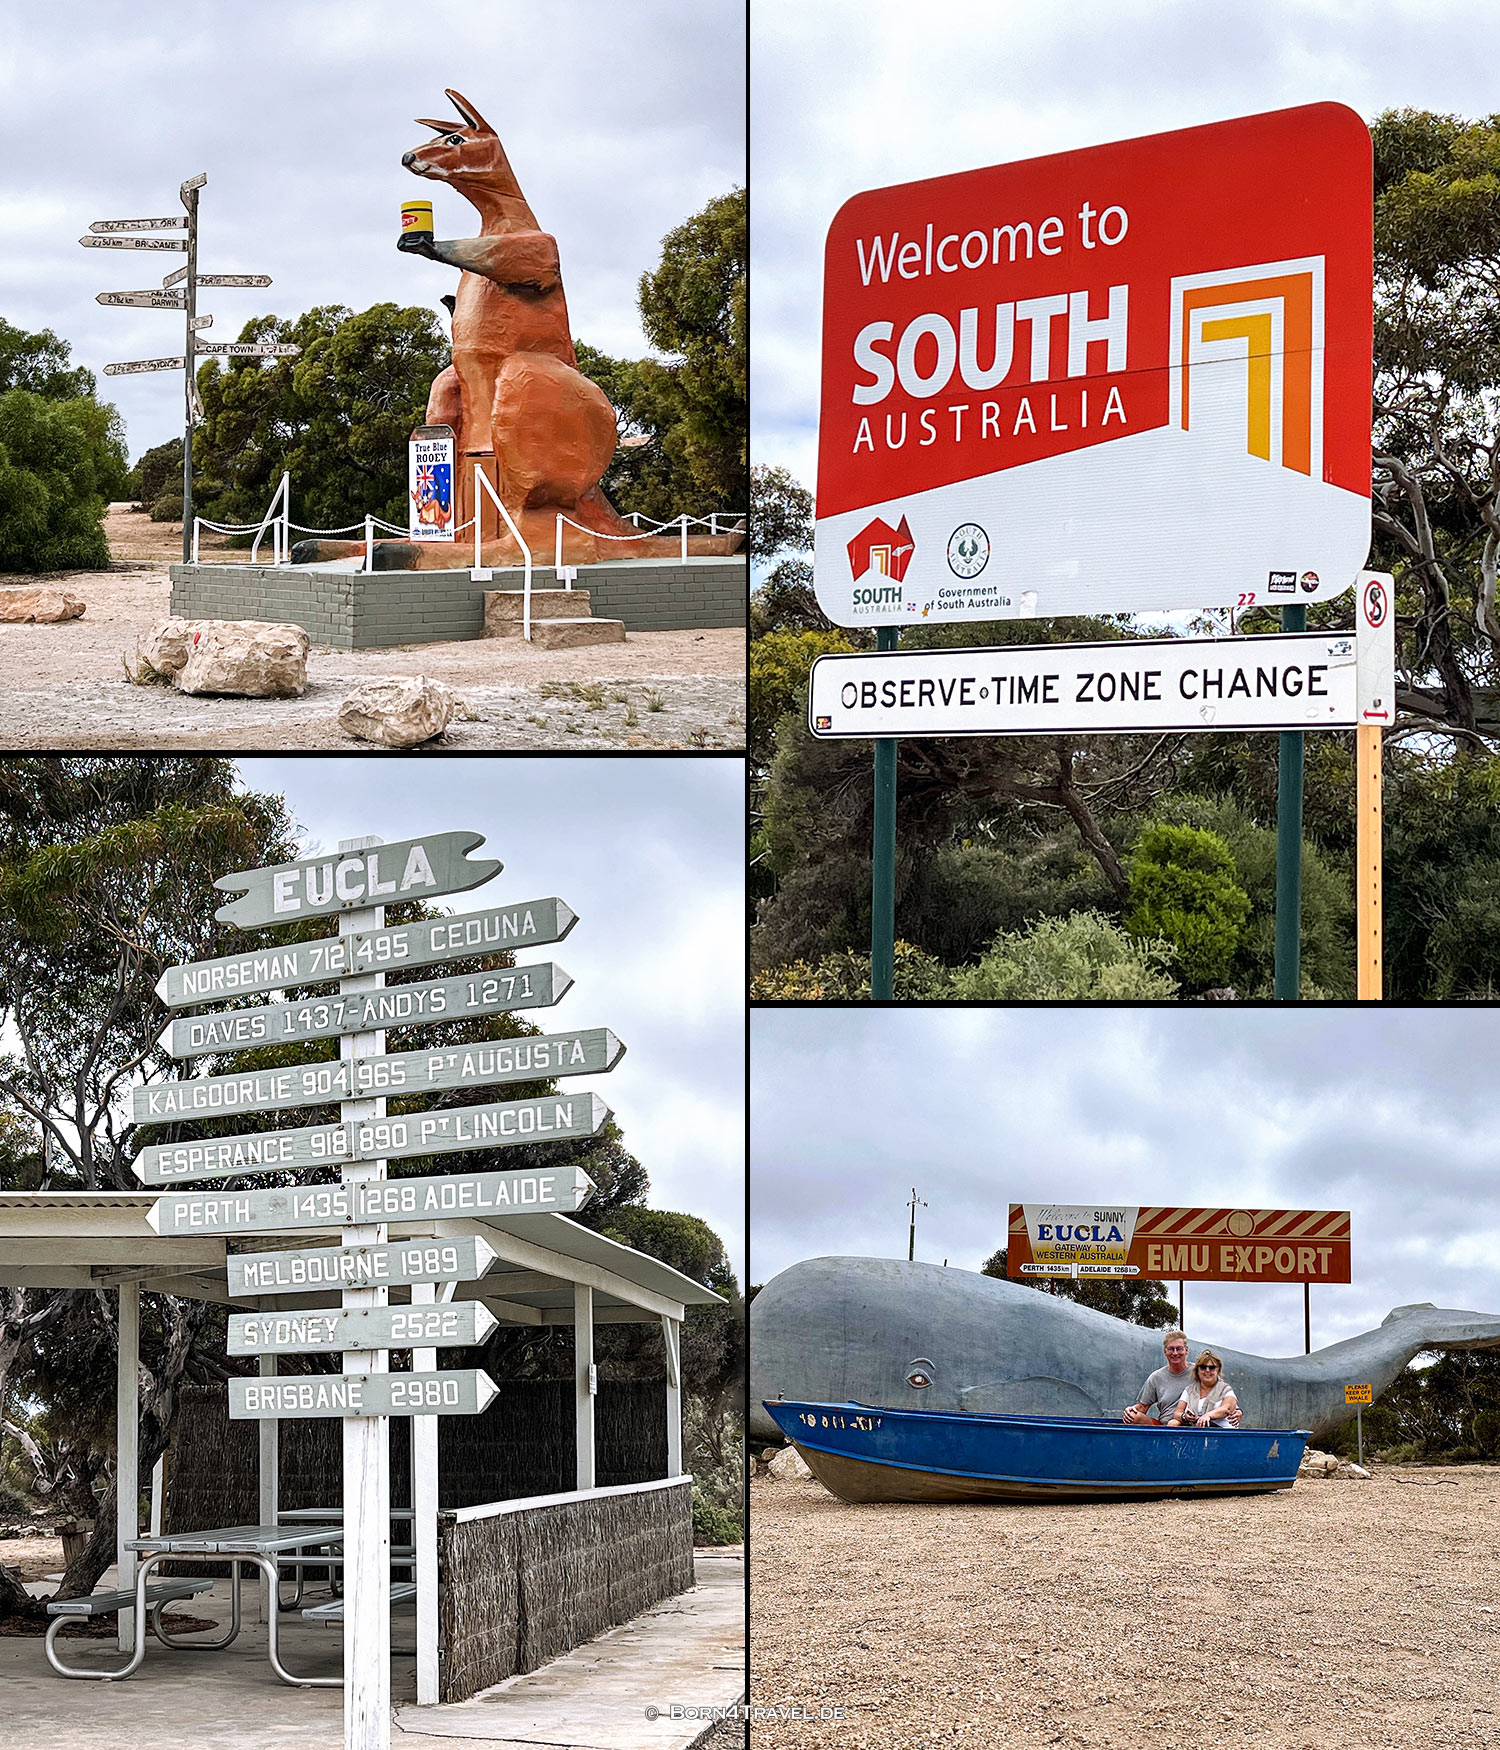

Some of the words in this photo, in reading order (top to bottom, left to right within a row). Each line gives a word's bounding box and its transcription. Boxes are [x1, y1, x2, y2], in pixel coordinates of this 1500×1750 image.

[856, 216, 1064, 286] Welcome
[1078, 201, 1129, 249] to
[151, 298, 179, 308] DARWIN
[205, 344, 227, 354] CAPE
[228, 344, 254, 354] TOWN
[852, 284, 1129, 405] SOUTH
[853, 386, 1127, 454] AUSTRALIA
[415, 443, 430, 452] True
[432, 442, 447, 452] Blue
[416, 452, 447, 463] ROOEY
[853, 586, 902, 605] SOUTH
[924, 600, 934, 611] of
[938, 599, 964, 610] South
[968, 596, 1011, 608] Australia
[938, 586, 997, 598] Government
[1238, 592, 1256, 606] 22
[853, 605, 902, 614] AUSTRALIA
[841, 678, 976, 709] OBSERVE
[991, 674, 1060, 704] TIME
[1076, 670, 1162, 703] ZONE
[1179, 665, 1329, 700] CHANGE
[273, 844, 436, 914] EUCLA
[356, 932, 410, 964] 495
[430, 910, 537, 952] CEDUNA
[182, 954, 298, 996] NORSEMAN
[310, 944, 345, 972] 712
[190, 1014, 266, 1048] DAVES
[466, 974, 534, 1006] 1271
[358, 1060, 406, 1089] 965
[460, 1038, 586, 1074] AUGUSTA
[148, 1074, 292, 1116] KALGOORLIE
[302, 1067, 346, 1096] 904
[358, 1123, 408, 1152] 890
[456, 1102, 574, 1142] LINCOLN
[158, 1136, 294, 1175] ESPERANCE
[310, 1129, 347, 1158] 918
[174, 1198, 250, 1228] PERTH
[293, 1189, 348, 1220] 1435
[358, 1185, 416, 1215] 1268
[423, 1176, 556, 1211] ADELAIDE
[1038, 1224, 1124, 1242] EUCLA
[1054, 1244, 1092, 1252] GATEWAY
[1096, 1244, 1106, 1252] TO
[243, 1252, 390, 1286] MELBOURNE
[400, 1247, 458, 1276] 1989
[1022, 1264, 1044, 1272] PERTH
[1036, 1252, 1076, 1260] WESTERN
[1080, 1252, 1124, 1260] AUSTRALIA
[1147, 1244, 1210, 1273] EMU
[1220, 1244, 1333, 1275] EXPORT
[243, 1317, 339, 1346] SYDNEY
[390, 1312, 458, 1340] 2522
[244, 1383, 364, 1411] BRISBANE
[390, 1380, 458, 1408] 2980
